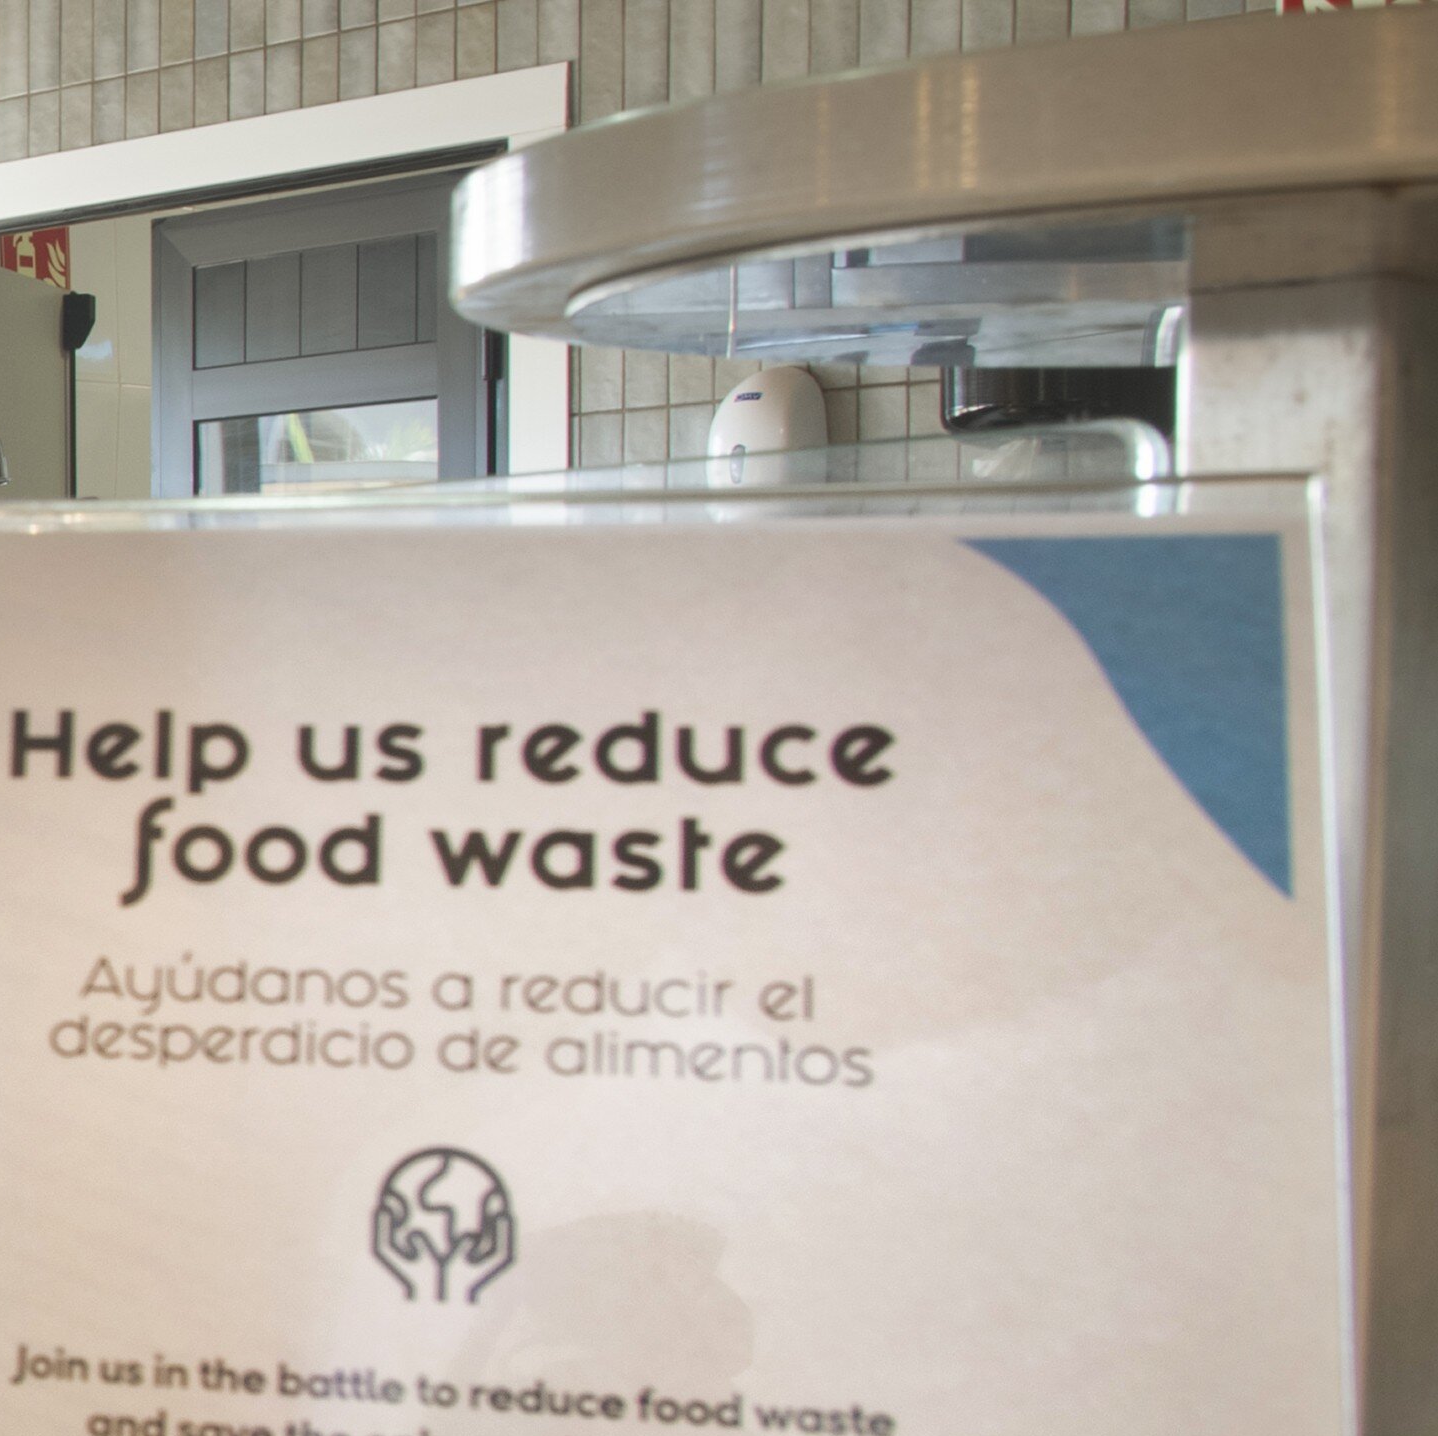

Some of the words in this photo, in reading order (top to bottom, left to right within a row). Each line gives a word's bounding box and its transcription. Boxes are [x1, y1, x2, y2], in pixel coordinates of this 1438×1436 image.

[9, 708, 251, 795] Help
[296, 722, 428, 783] us
[475, 708, 896, 788] reduce
[118, 796, 384, 908] food
[429, 816, 785, 893] waste
[79, 949, 411, 1017] Ayúdanos
[431, 972, 474, 1012] a
[499, 968, 735, 1018] reducir
[758, 975, 816, 1022] el
[48, 1015, 415, 1071] desperdicio
[437, 1026, 520, 1074] de
[545, 1028, 876, 1088] alimentos
[10, 1346, 89, 1386] Join
[99, 1358, 143, 1385] us
[153, 1353, 189, 1389] in
[198, 1358, 267, 1394] the
[276, 1361, 404, 1401] battle
[417, 1375, 460, 1408] to
[469, 1379, 627, 1420] reduce
[637, 1386, 744, 1429] food
